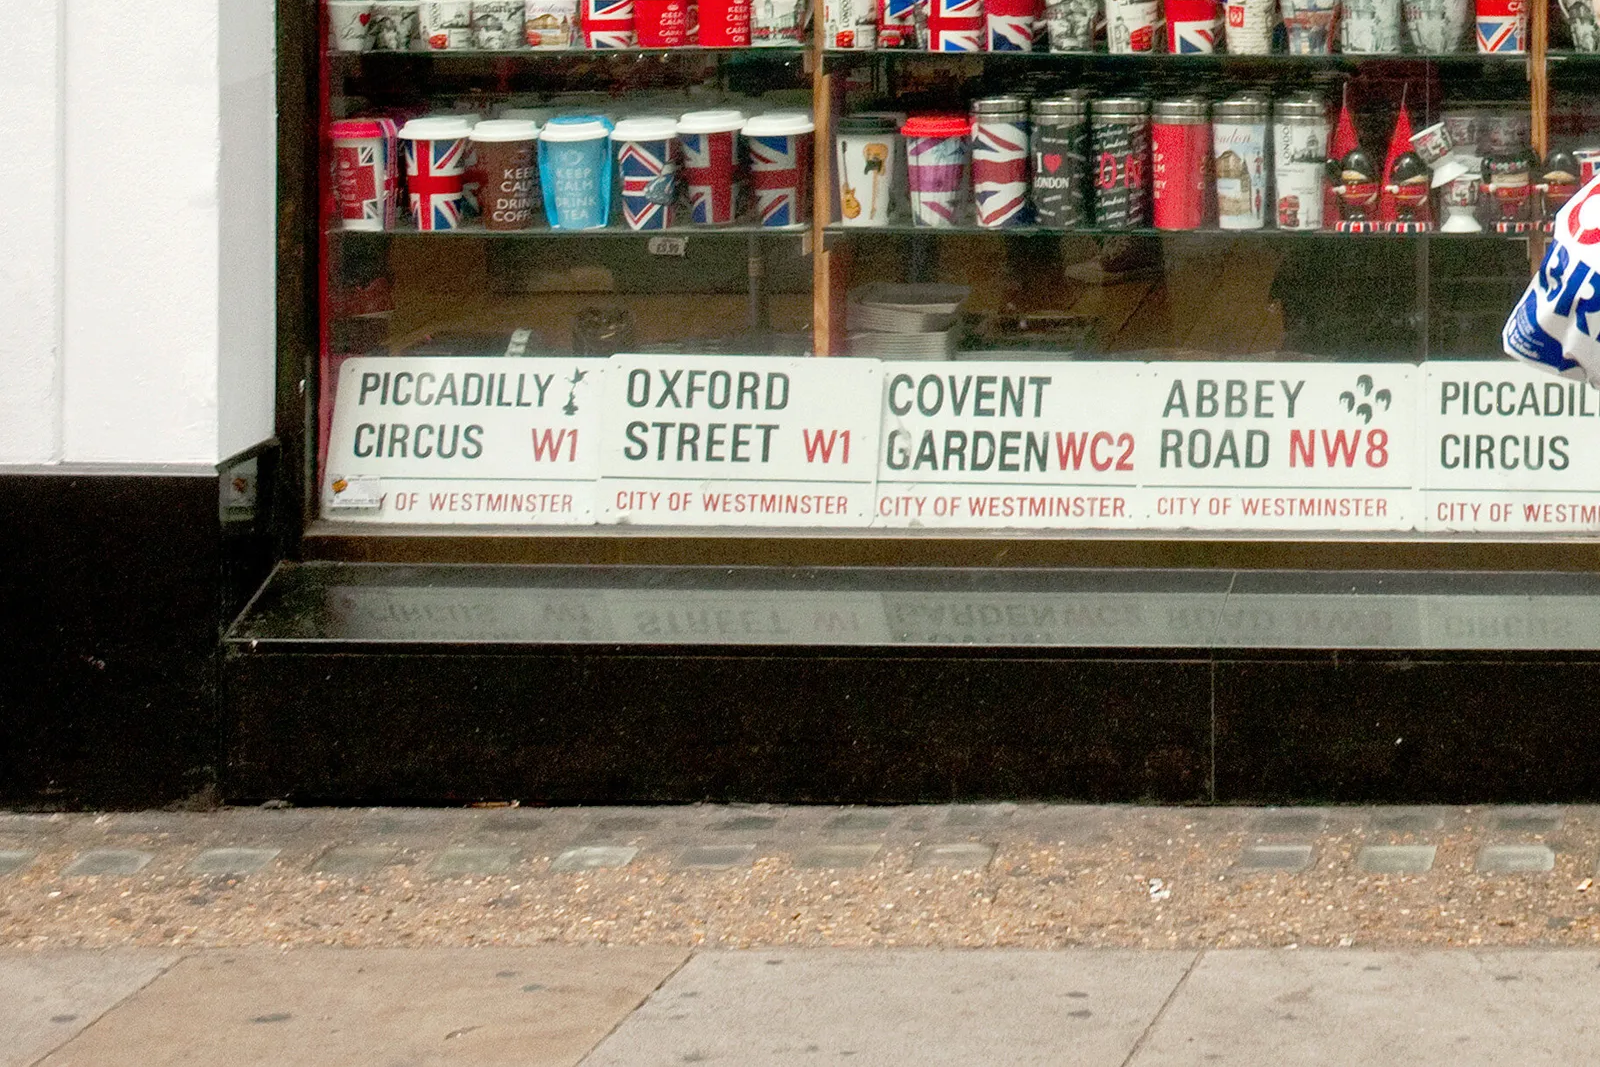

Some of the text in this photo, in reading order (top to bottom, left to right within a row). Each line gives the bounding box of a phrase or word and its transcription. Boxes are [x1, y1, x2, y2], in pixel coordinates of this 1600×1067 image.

[1034, 177, 1070, 189] LONDON
[358, 371, 554, 408] PICCADILLY
[625, 367, 790, 410] OXFORD
[888, 373, 1052, 418] COVENT
[1162, 379, 1306, 419] ABBEY
[353, 422, 579, 463] CIRCUS W1
[623, 422, 851, 464] STREET W1
[886, 429, 1135, 472] GARDEN WC2
[1160, 428, 1389, 469] ROAD NW8
[1440, 434, 1570, 470] CIRCUS
[396, 492, 418, 513] OF
[429, 492, 573, 514] WESTMINSTER
[616, 491, 848, 515] CITY OF WESTMINSTER
[880, 497, 1126, 519] CITY OF WESTMINSTER
[1157, 497, 1388, 517] CITY OF WESTMINSTER
[1437, 502, 1480, 523] CITY
[1489, 503, 1513, 523] OF
